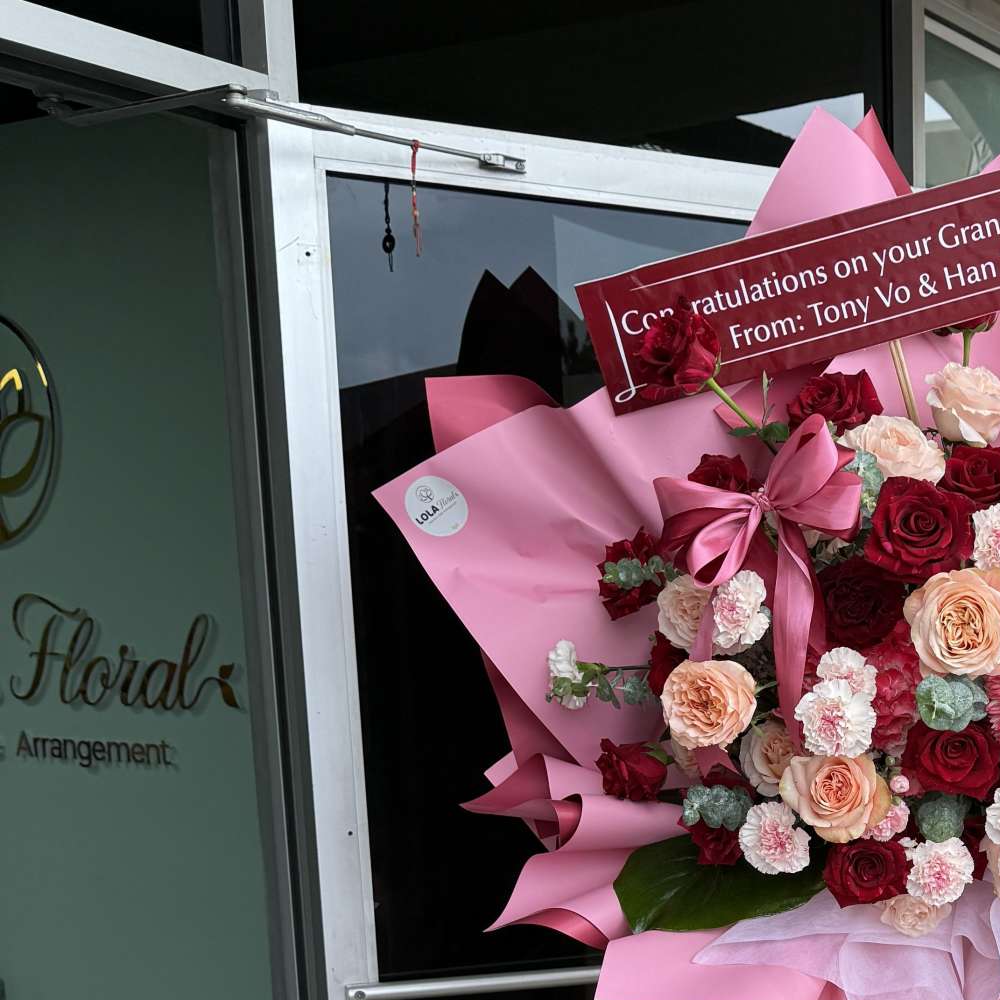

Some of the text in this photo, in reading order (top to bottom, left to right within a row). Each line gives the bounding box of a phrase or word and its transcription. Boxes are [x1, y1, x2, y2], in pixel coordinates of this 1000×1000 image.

[621, 265, 828, 336] Conratulations
[834, 254, 869, 279] on
[872, 235, 932, 277] your
[729, 313, 805, 350] From:
[807, 296, 870, 327] Tony
[874, 282, 911, 308] Vo
[918, 273, 939, 298] &
[943, 261, 998, 290] Han
[415, 505, 440, 525] LOLA
[9, 592, 240, 711] Floral
[16, 729, 173, 769] Arrangement
